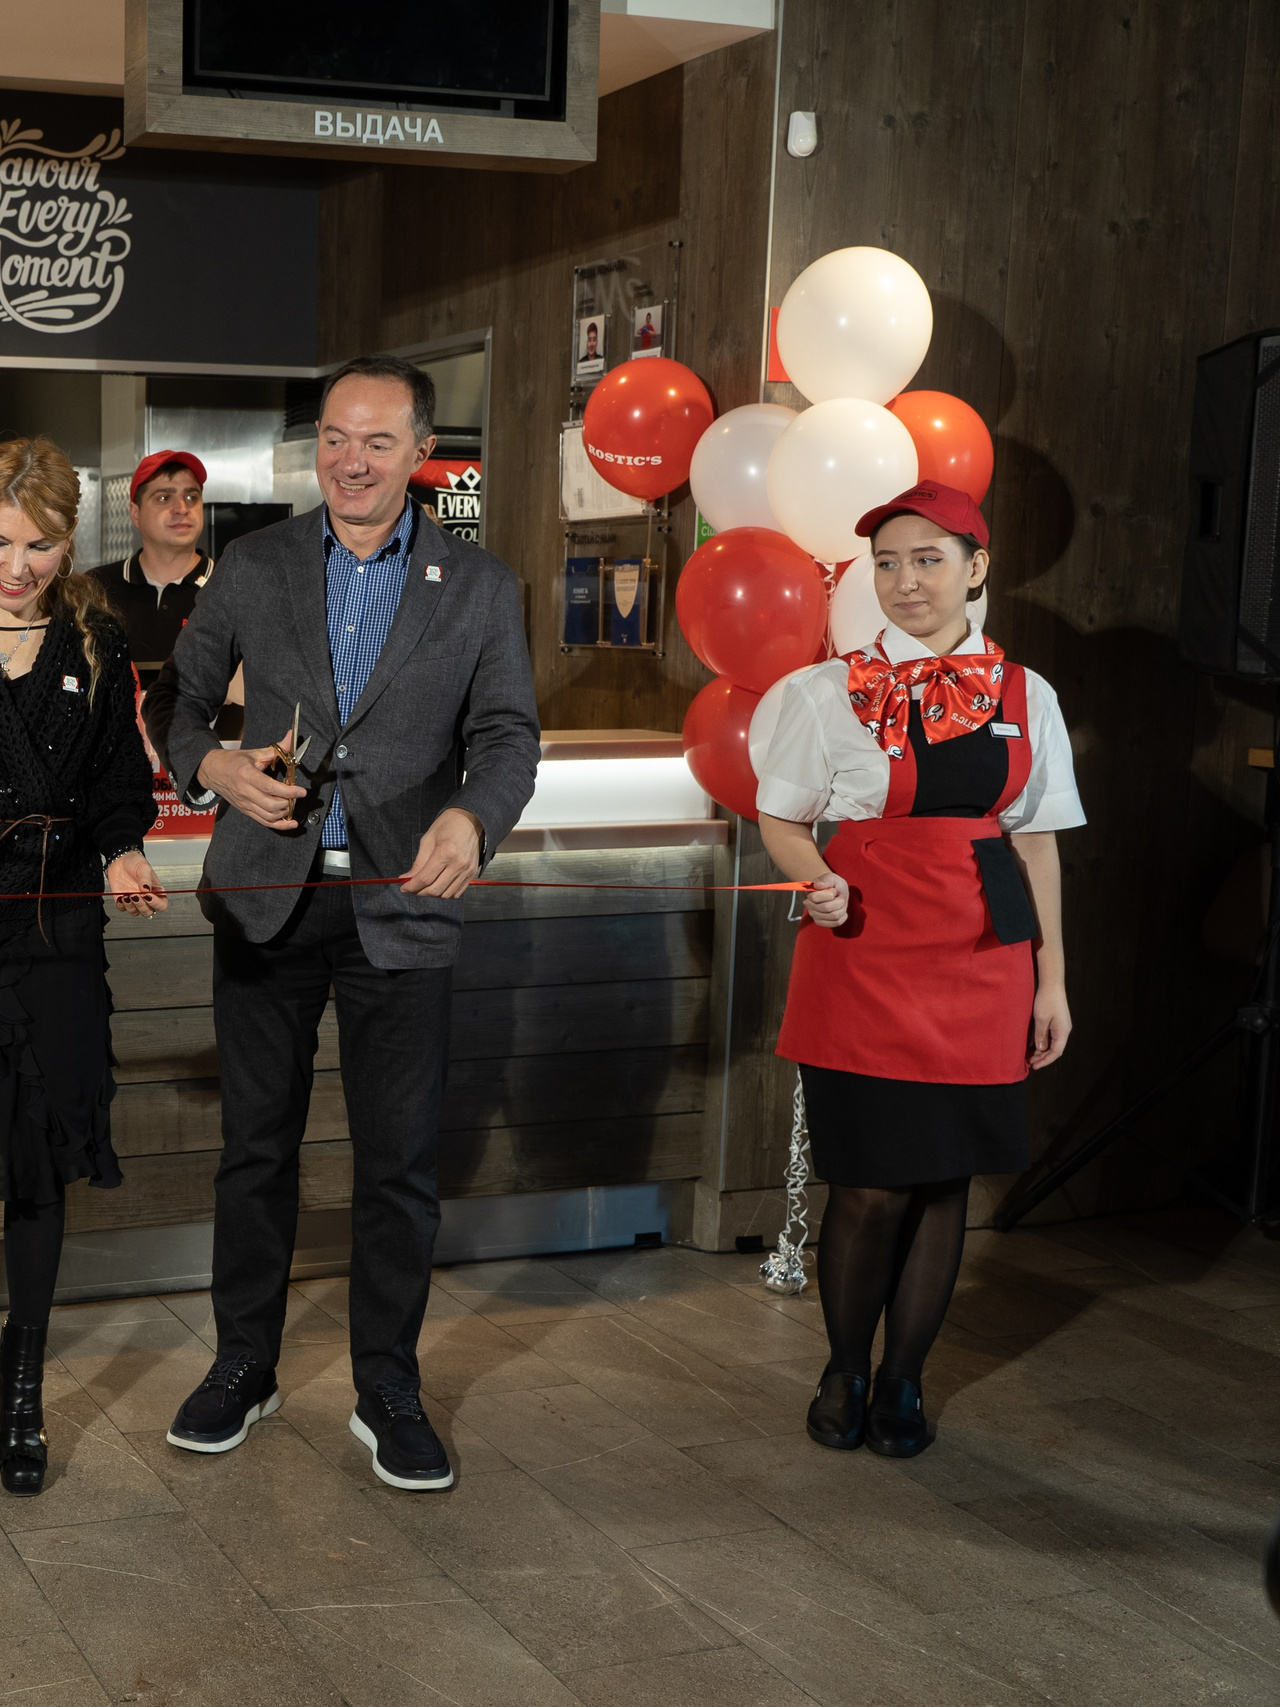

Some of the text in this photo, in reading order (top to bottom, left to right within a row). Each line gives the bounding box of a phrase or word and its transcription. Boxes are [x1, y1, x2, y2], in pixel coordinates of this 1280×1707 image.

[314, 110, 444, 145] ВЫДАЧА
[587, 443, 663, 466] ROSTIC'S
[437, 493, 480, 518] EVERV
[452, 527, 480, 543] COL
[950, 712, 981, 731] STIC'S
